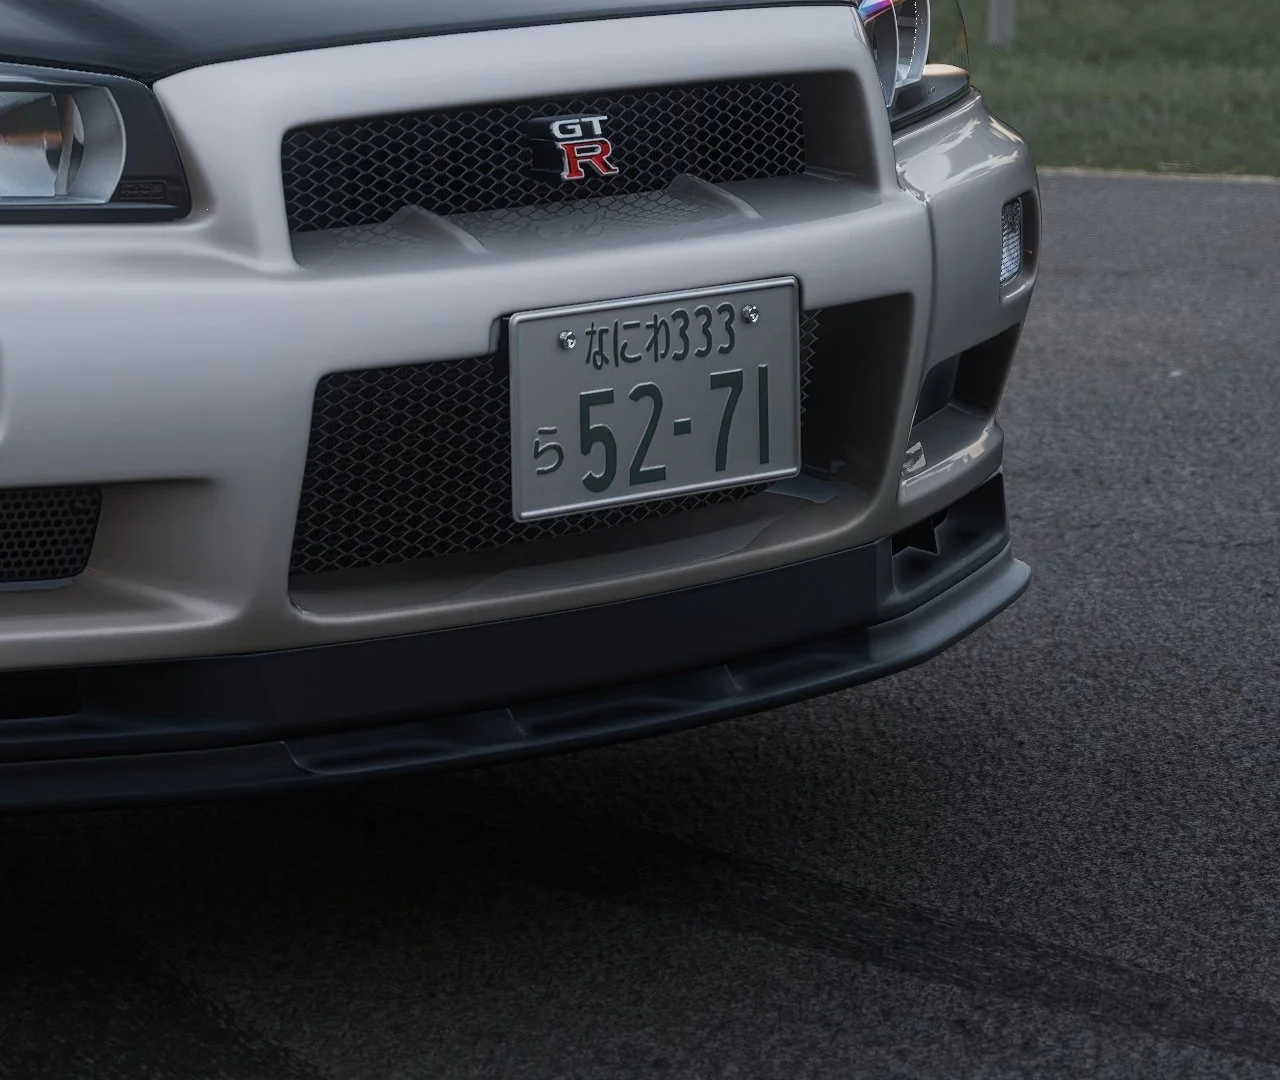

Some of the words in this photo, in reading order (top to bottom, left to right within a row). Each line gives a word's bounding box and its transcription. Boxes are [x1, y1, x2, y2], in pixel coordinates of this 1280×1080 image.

[551, 115, 608, 139] GT
[555, 137, 619, 180] R
[533, 426, 564, 475] ら
[578, 363, 770, 493] 52-71
